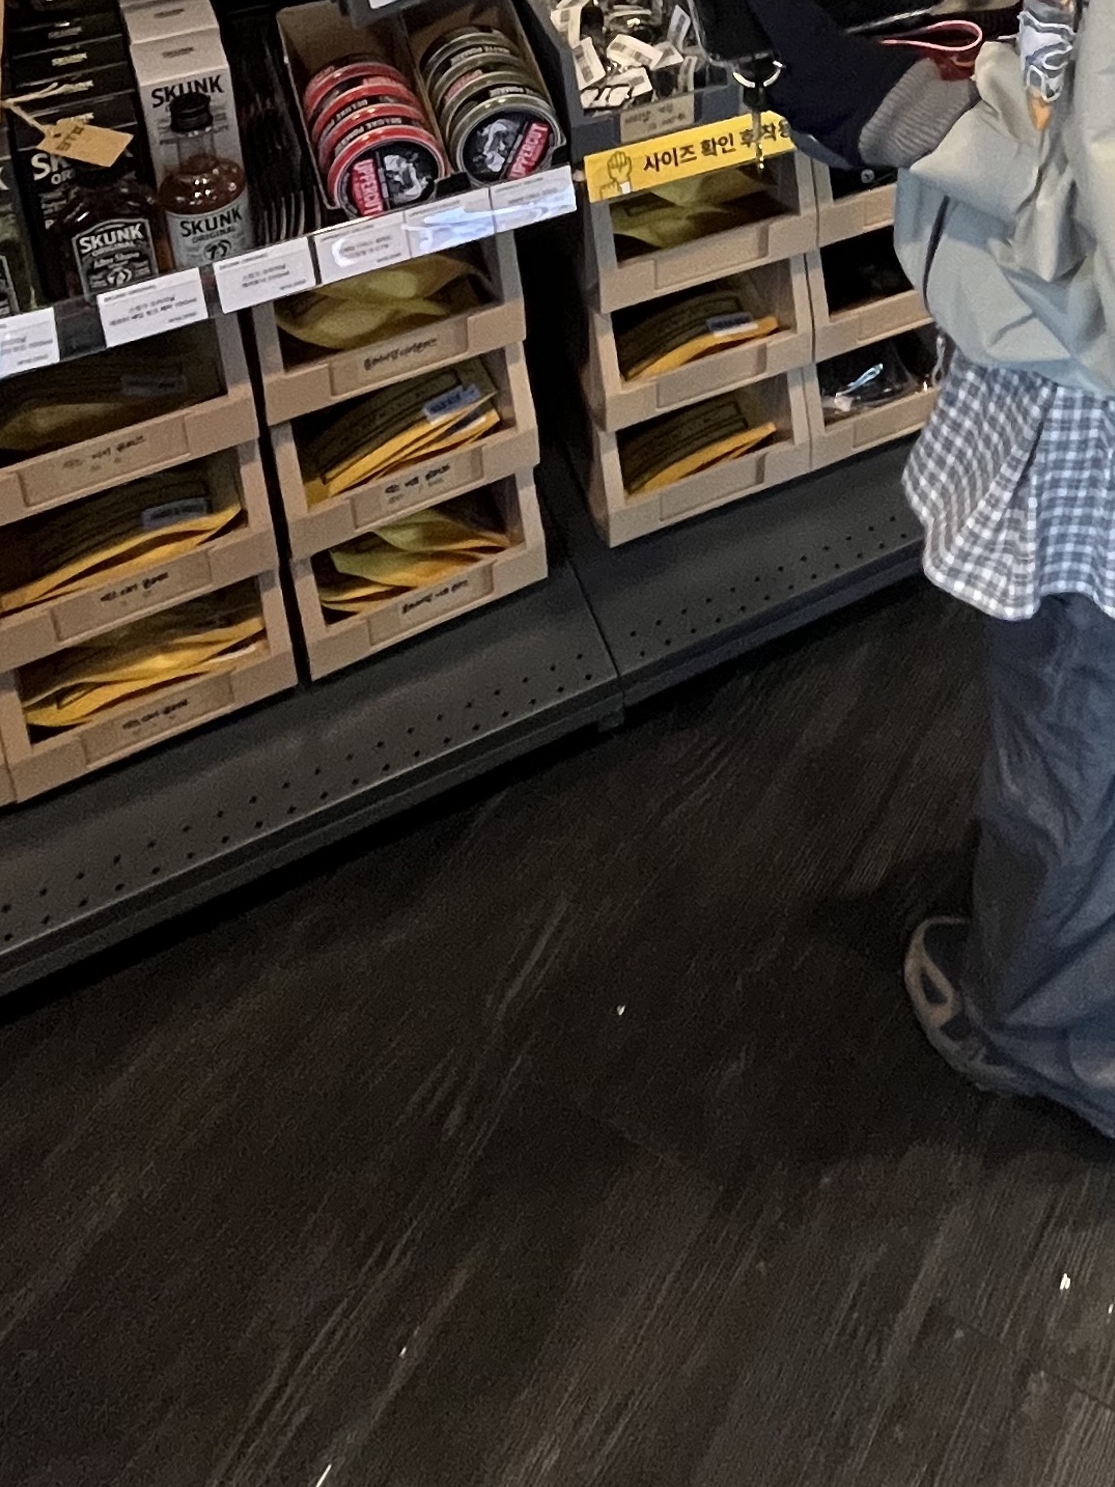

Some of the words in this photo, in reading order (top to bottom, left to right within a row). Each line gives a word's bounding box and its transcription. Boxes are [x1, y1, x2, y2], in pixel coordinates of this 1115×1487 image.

[151, 74, 224, 108] SKUNK
[643, 145, 698, 172] 사이즈
[700, 132, 736, 157] 확인
[353, 158, 385, 216] UPPERCUT
[79, 223, 144, 254] SKUNK
[180, 205, 243, 238] SKUNK
